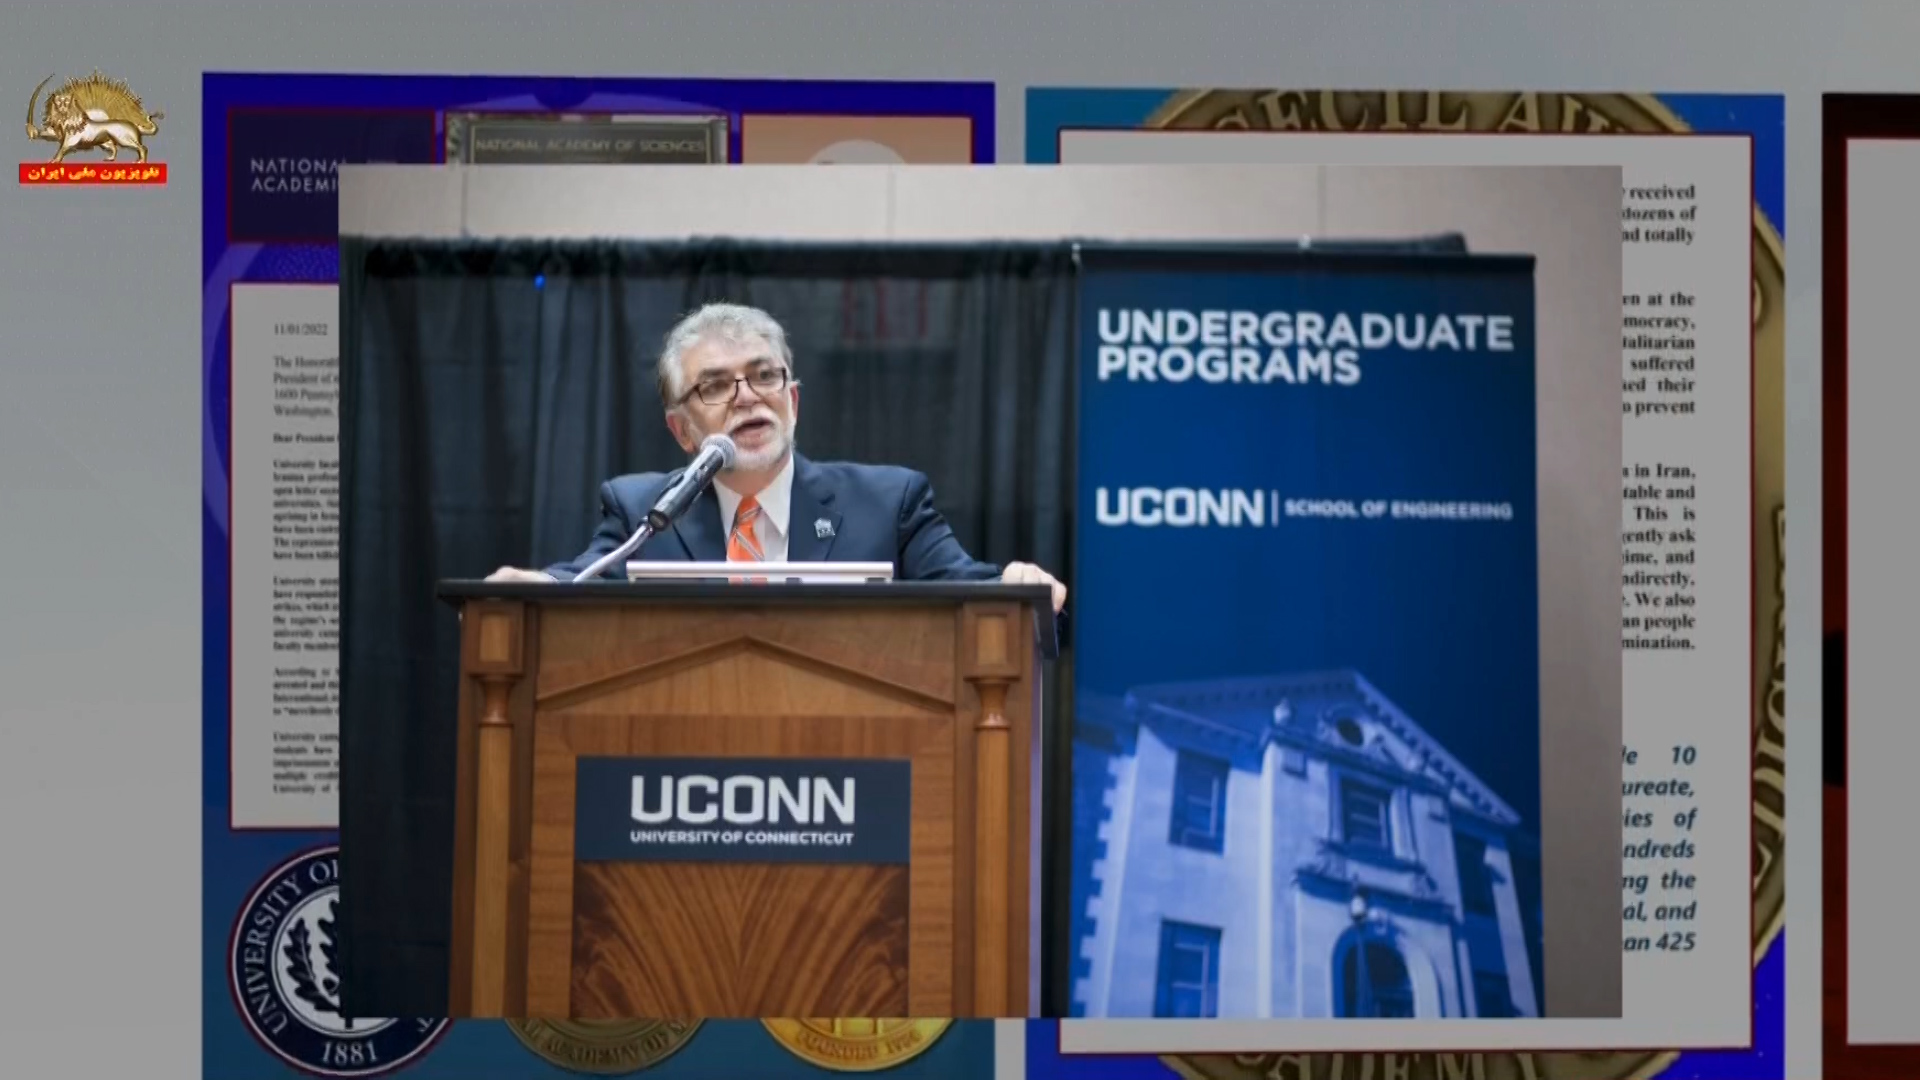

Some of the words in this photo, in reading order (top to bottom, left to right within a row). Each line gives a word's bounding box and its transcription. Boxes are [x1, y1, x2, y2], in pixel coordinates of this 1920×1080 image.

[475, 139, 539, 151] NATIONAL
[546, 139, 611, 151] ACADEMY
[614, 139, 635, 151] OF
[639, 140, 705, 153] SCIENCES
[250, 157, 346, 174] NATIONA
[1630, 184, 1695, 200] received
[1680, 205, 1698, 220] of
[1645, 227, 1694, 246] totally
[1647, 293, 1662, 306] at
[1671, 292, 1696, 307] the
[1098, 309, 1515, 351] UNDERGRADUATE
[273, 355, 292, 368] The
[1098, 346, 1361, 386] PROGRAMS
[1630, 356, 1695, 371] suffered
[1658, 378, 1695, 392] their
[1635, 401, 1695, 418] prevent
[1634, 464, 1650, 478] in
[1656, 463, 1696, 479] Iran,
[1666, 484, 1695, 500] and
[1096, 487, 1265, 527] UCONN
[1285, 499, 1360, 518] SCHOOL
[1362, 500, 1388, 518] OF
[1391, 500, 1514, 520] ENGINEERING
[1633, 506, 1668, 521] This
[1683, 506, 1696, 521] is
[1669, 527, 1696, 542] ask
[1622, 550, 1658, 565] ime,
[1665, 548, 1695, 564] and
[1635, 592, 1661, 606] We
[1665, 592, 1696, 607] also
[1644, 613, 1697, 632] people
[1671, 745, 1697, 766] 10
[631, 775, 856, 824] UCONN
[1673, 806, 1698, 832] of
[630, 830, 720, 844] UNIVERSITY
[721, 831, 743, 844] OF
[745, 831, 854, 846] CONNECTICUT
[1623, 838, 1695, 859] ndreds
[1661, 869, 1697, 890] the
[1654, 900, 1697, 921] and
[1624, 937, 1650, 952] an
[1655, 931, 1697, 952] 425
[244, 873, 302, 1036] UNIVERSITY
[322, 1039, 378, 1065] 1881
